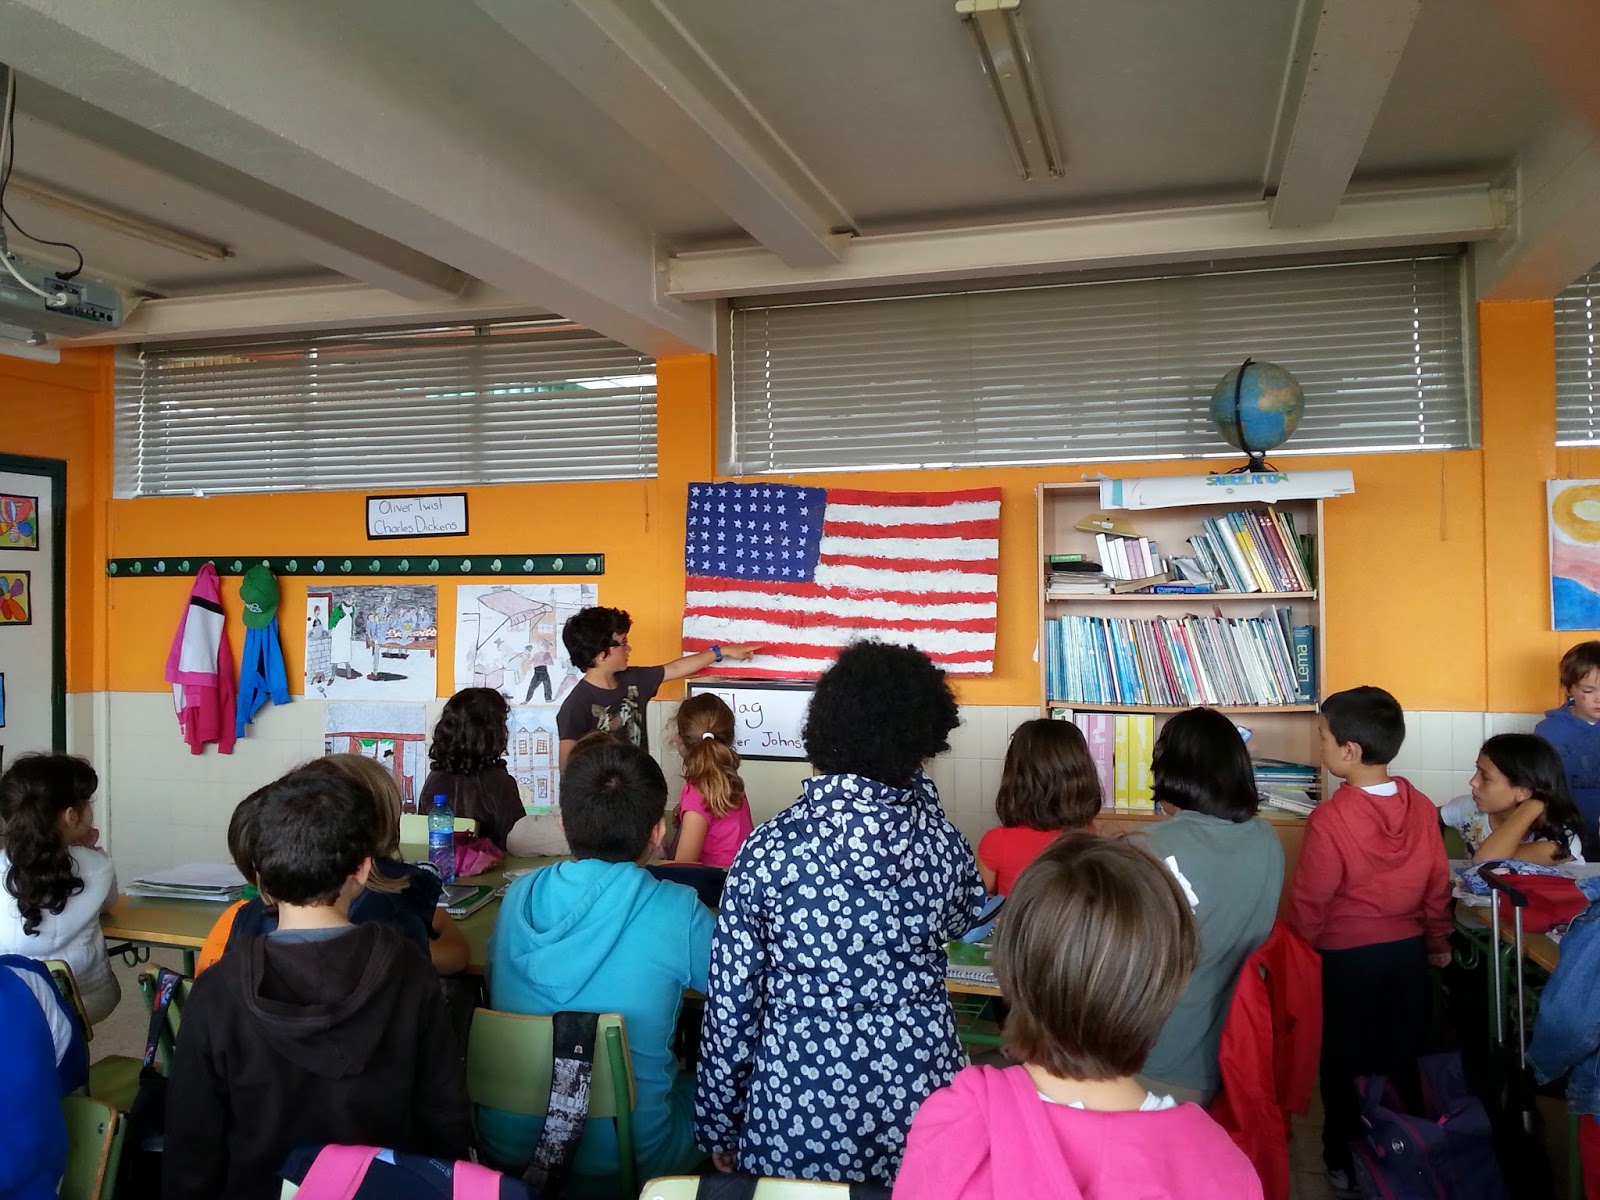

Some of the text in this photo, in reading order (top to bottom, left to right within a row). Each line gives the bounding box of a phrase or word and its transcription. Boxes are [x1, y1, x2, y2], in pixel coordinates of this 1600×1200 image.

[1206, 472, 1289, 486] MOUNTAINS
[379, 498, 443, 514] Oliver Twist
[374, 515, 458, 534] Charles Dickens
[1296, 644, 1309, 682] Lema
[762, 731, 802, 748] Johns
